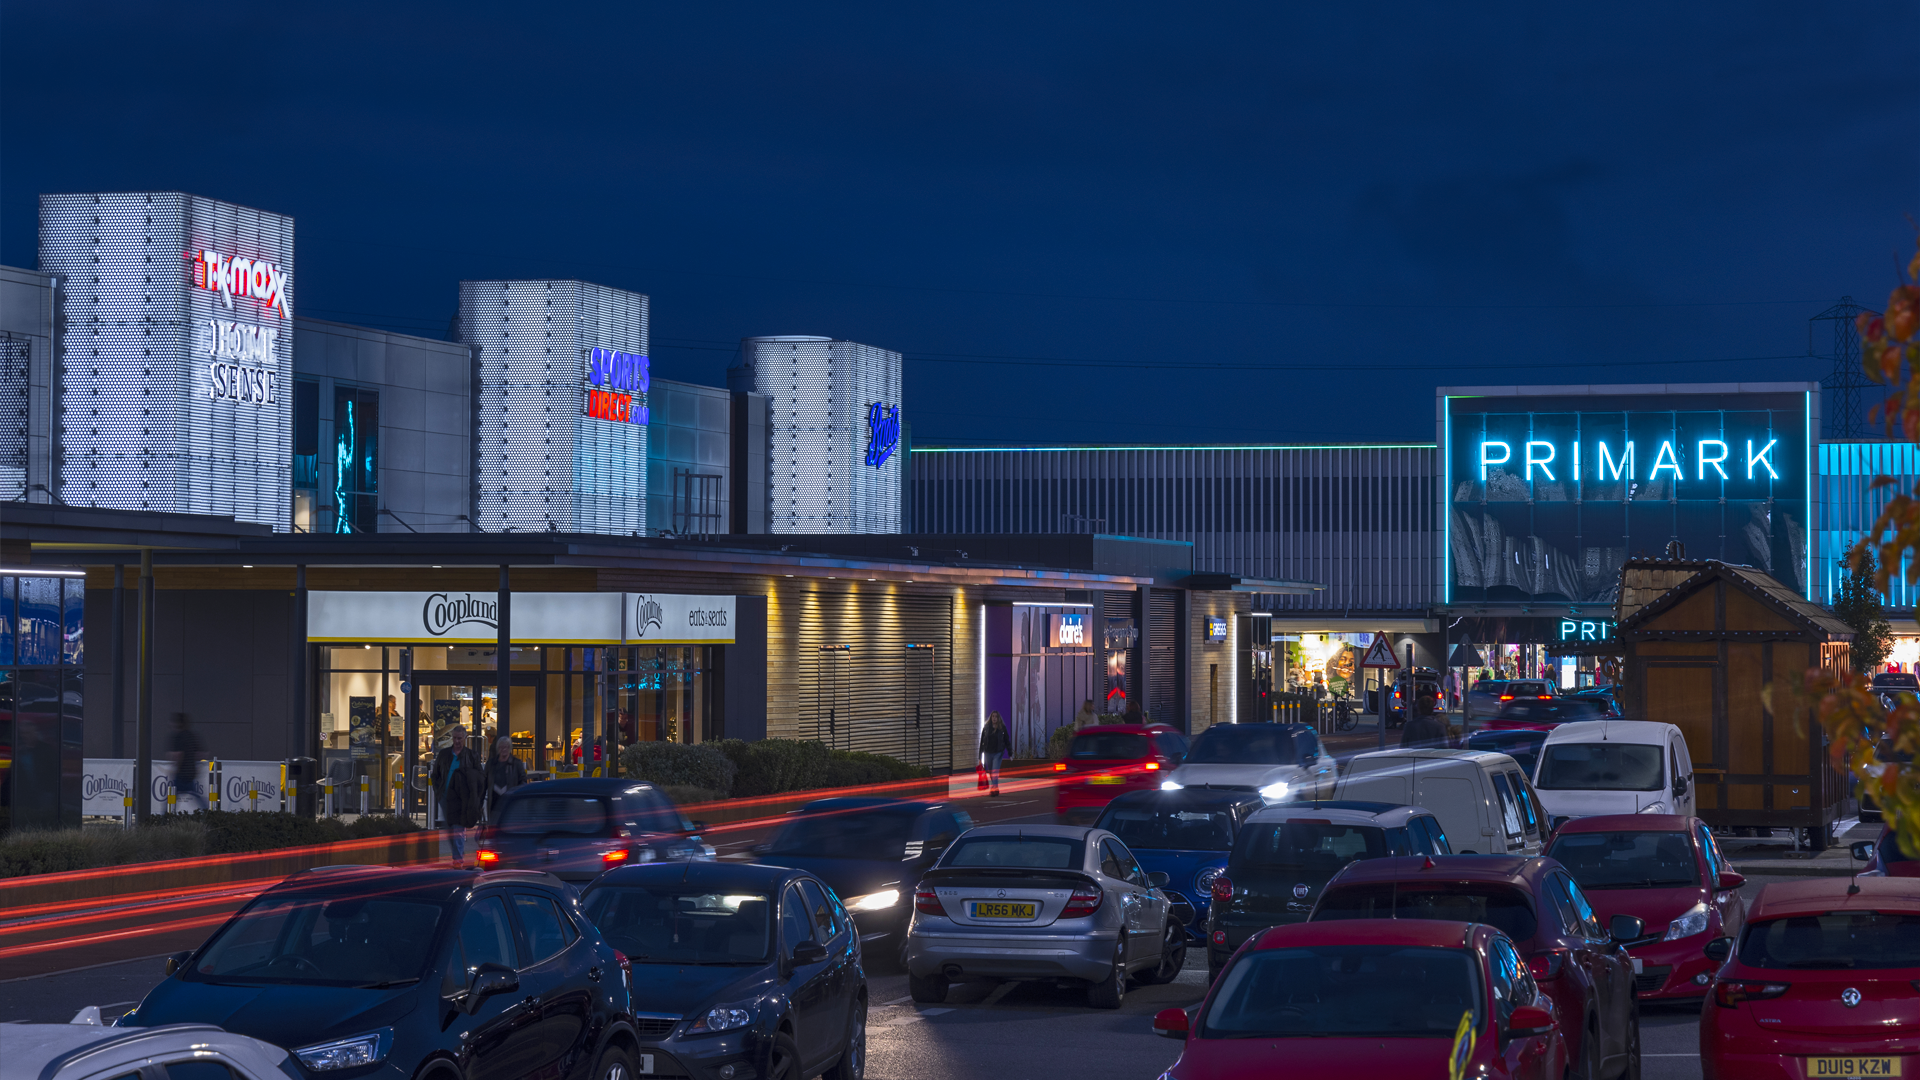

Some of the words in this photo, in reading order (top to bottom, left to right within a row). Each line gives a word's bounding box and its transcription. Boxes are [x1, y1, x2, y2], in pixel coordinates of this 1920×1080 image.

[213, 319, 278, 363] HOME
[214, 362, 277, 404] SENSE
[590, 347, 650, 393] SPORTS
[866, 402, 900, 469] Boots
[1480, 439, 1779, 481] PRIMARK
[423, 593, 498, 636] Coopland
[636, 594, 662, 637] Cooplands
[1060, 617, 1083, 644] claire's
[1561, 621, 1617, 640] PRI
[83, 774, 127, 801] Cooplands
[979, 904, 1008, 916] LR56
[1011, 905, 1034, 917] MKJ
[1817, 1059, 1853, 1075] DU19
[1859, 1059, 1891, 1075] KZW
